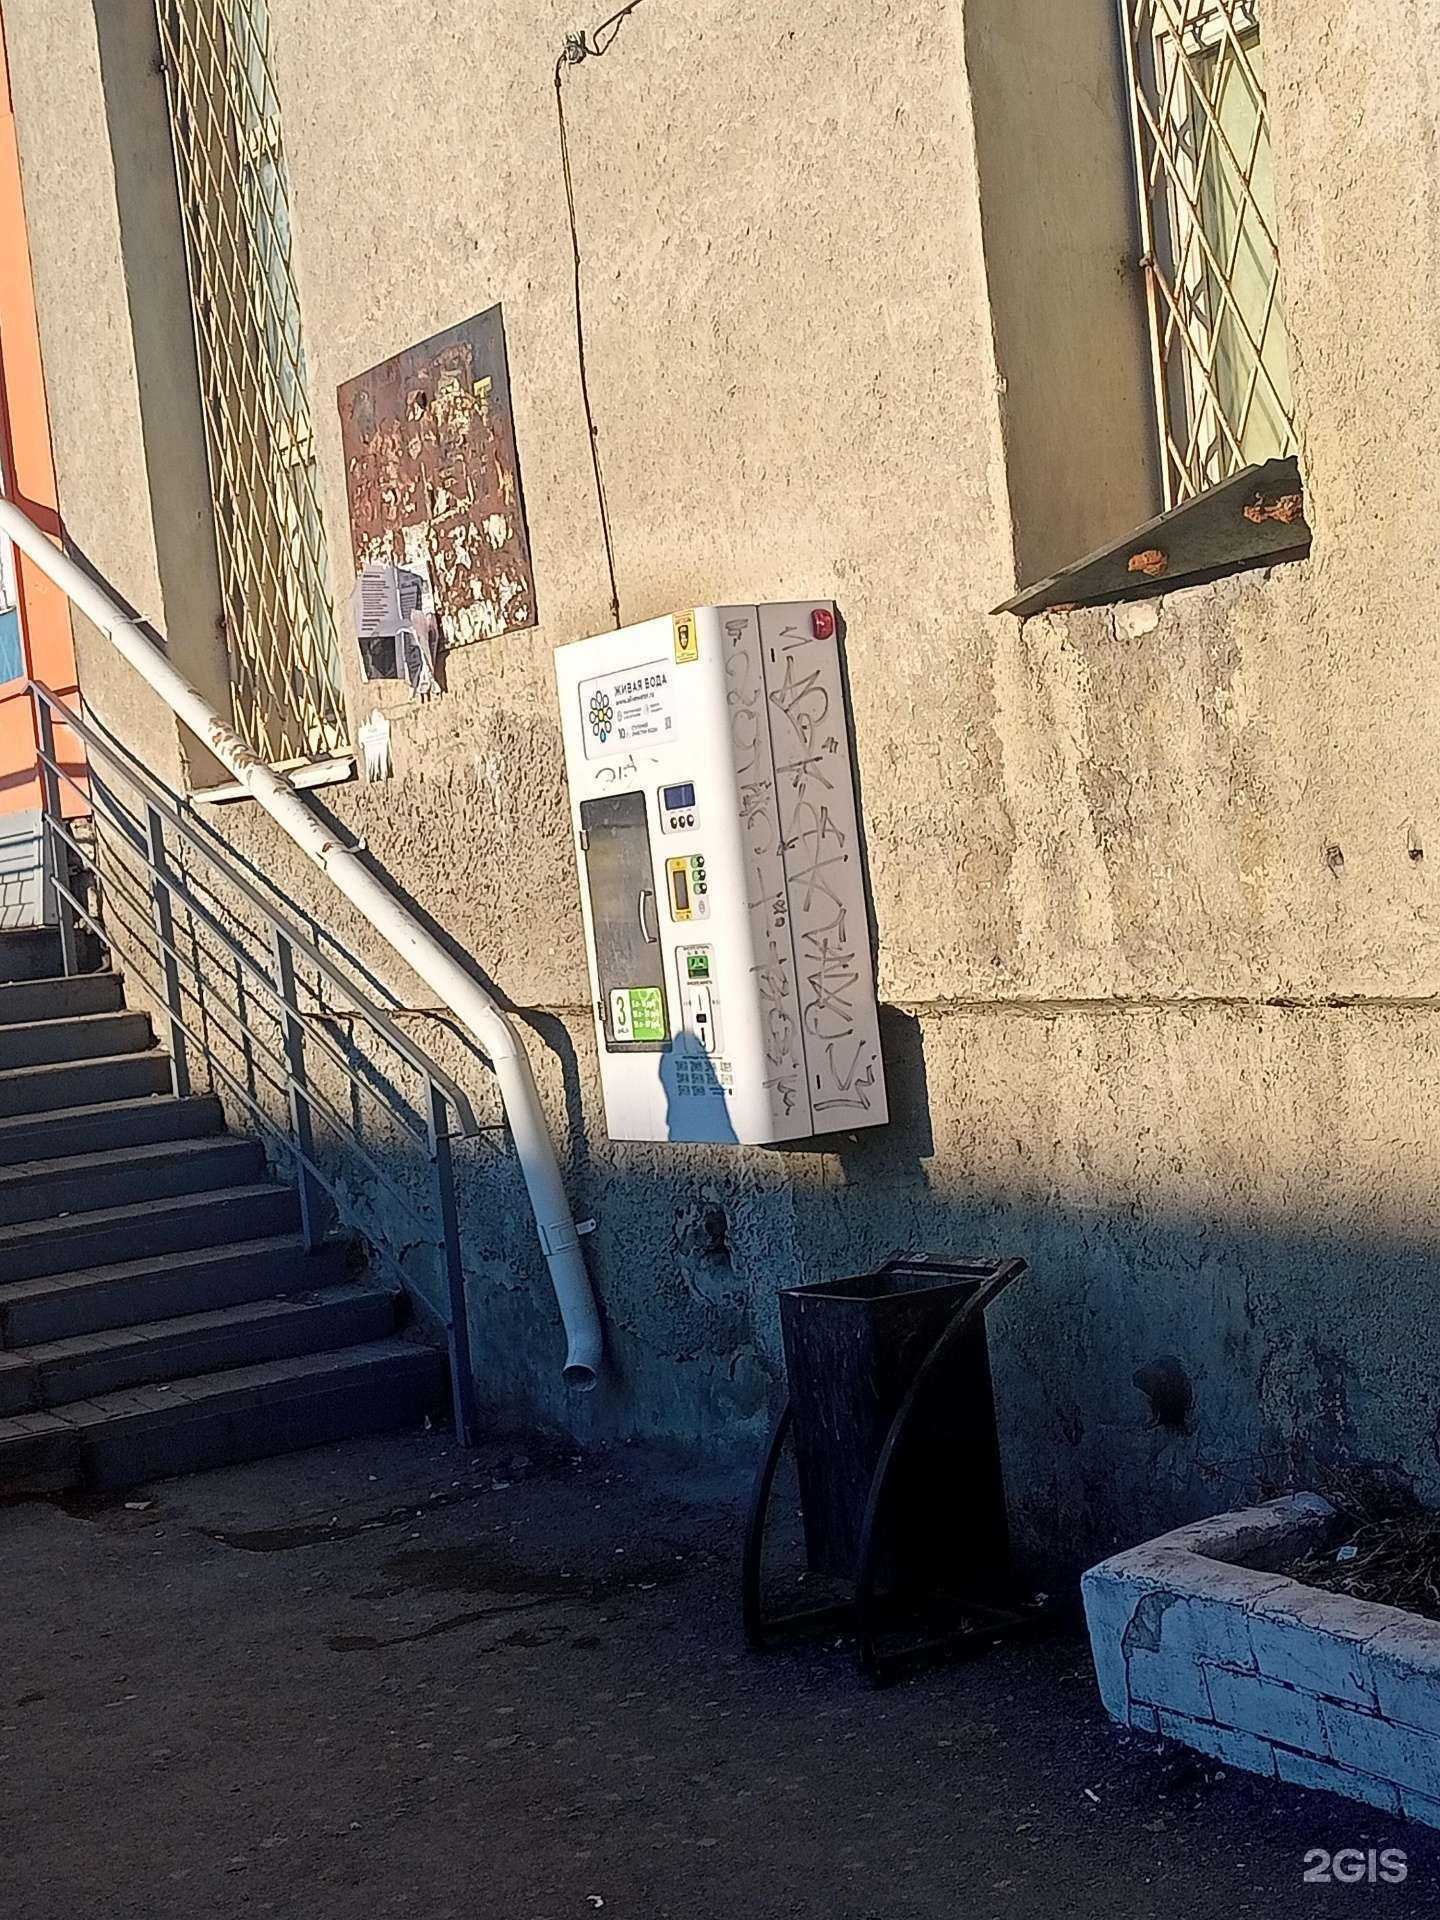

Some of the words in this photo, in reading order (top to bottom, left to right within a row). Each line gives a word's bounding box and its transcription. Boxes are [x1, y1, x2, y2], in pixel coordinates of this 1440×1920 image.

[614, 679, 642, 697] ЖИВАЯ
[644, 673, 668, 690] ВОДА
[616, 996, 626, 1026] 3
